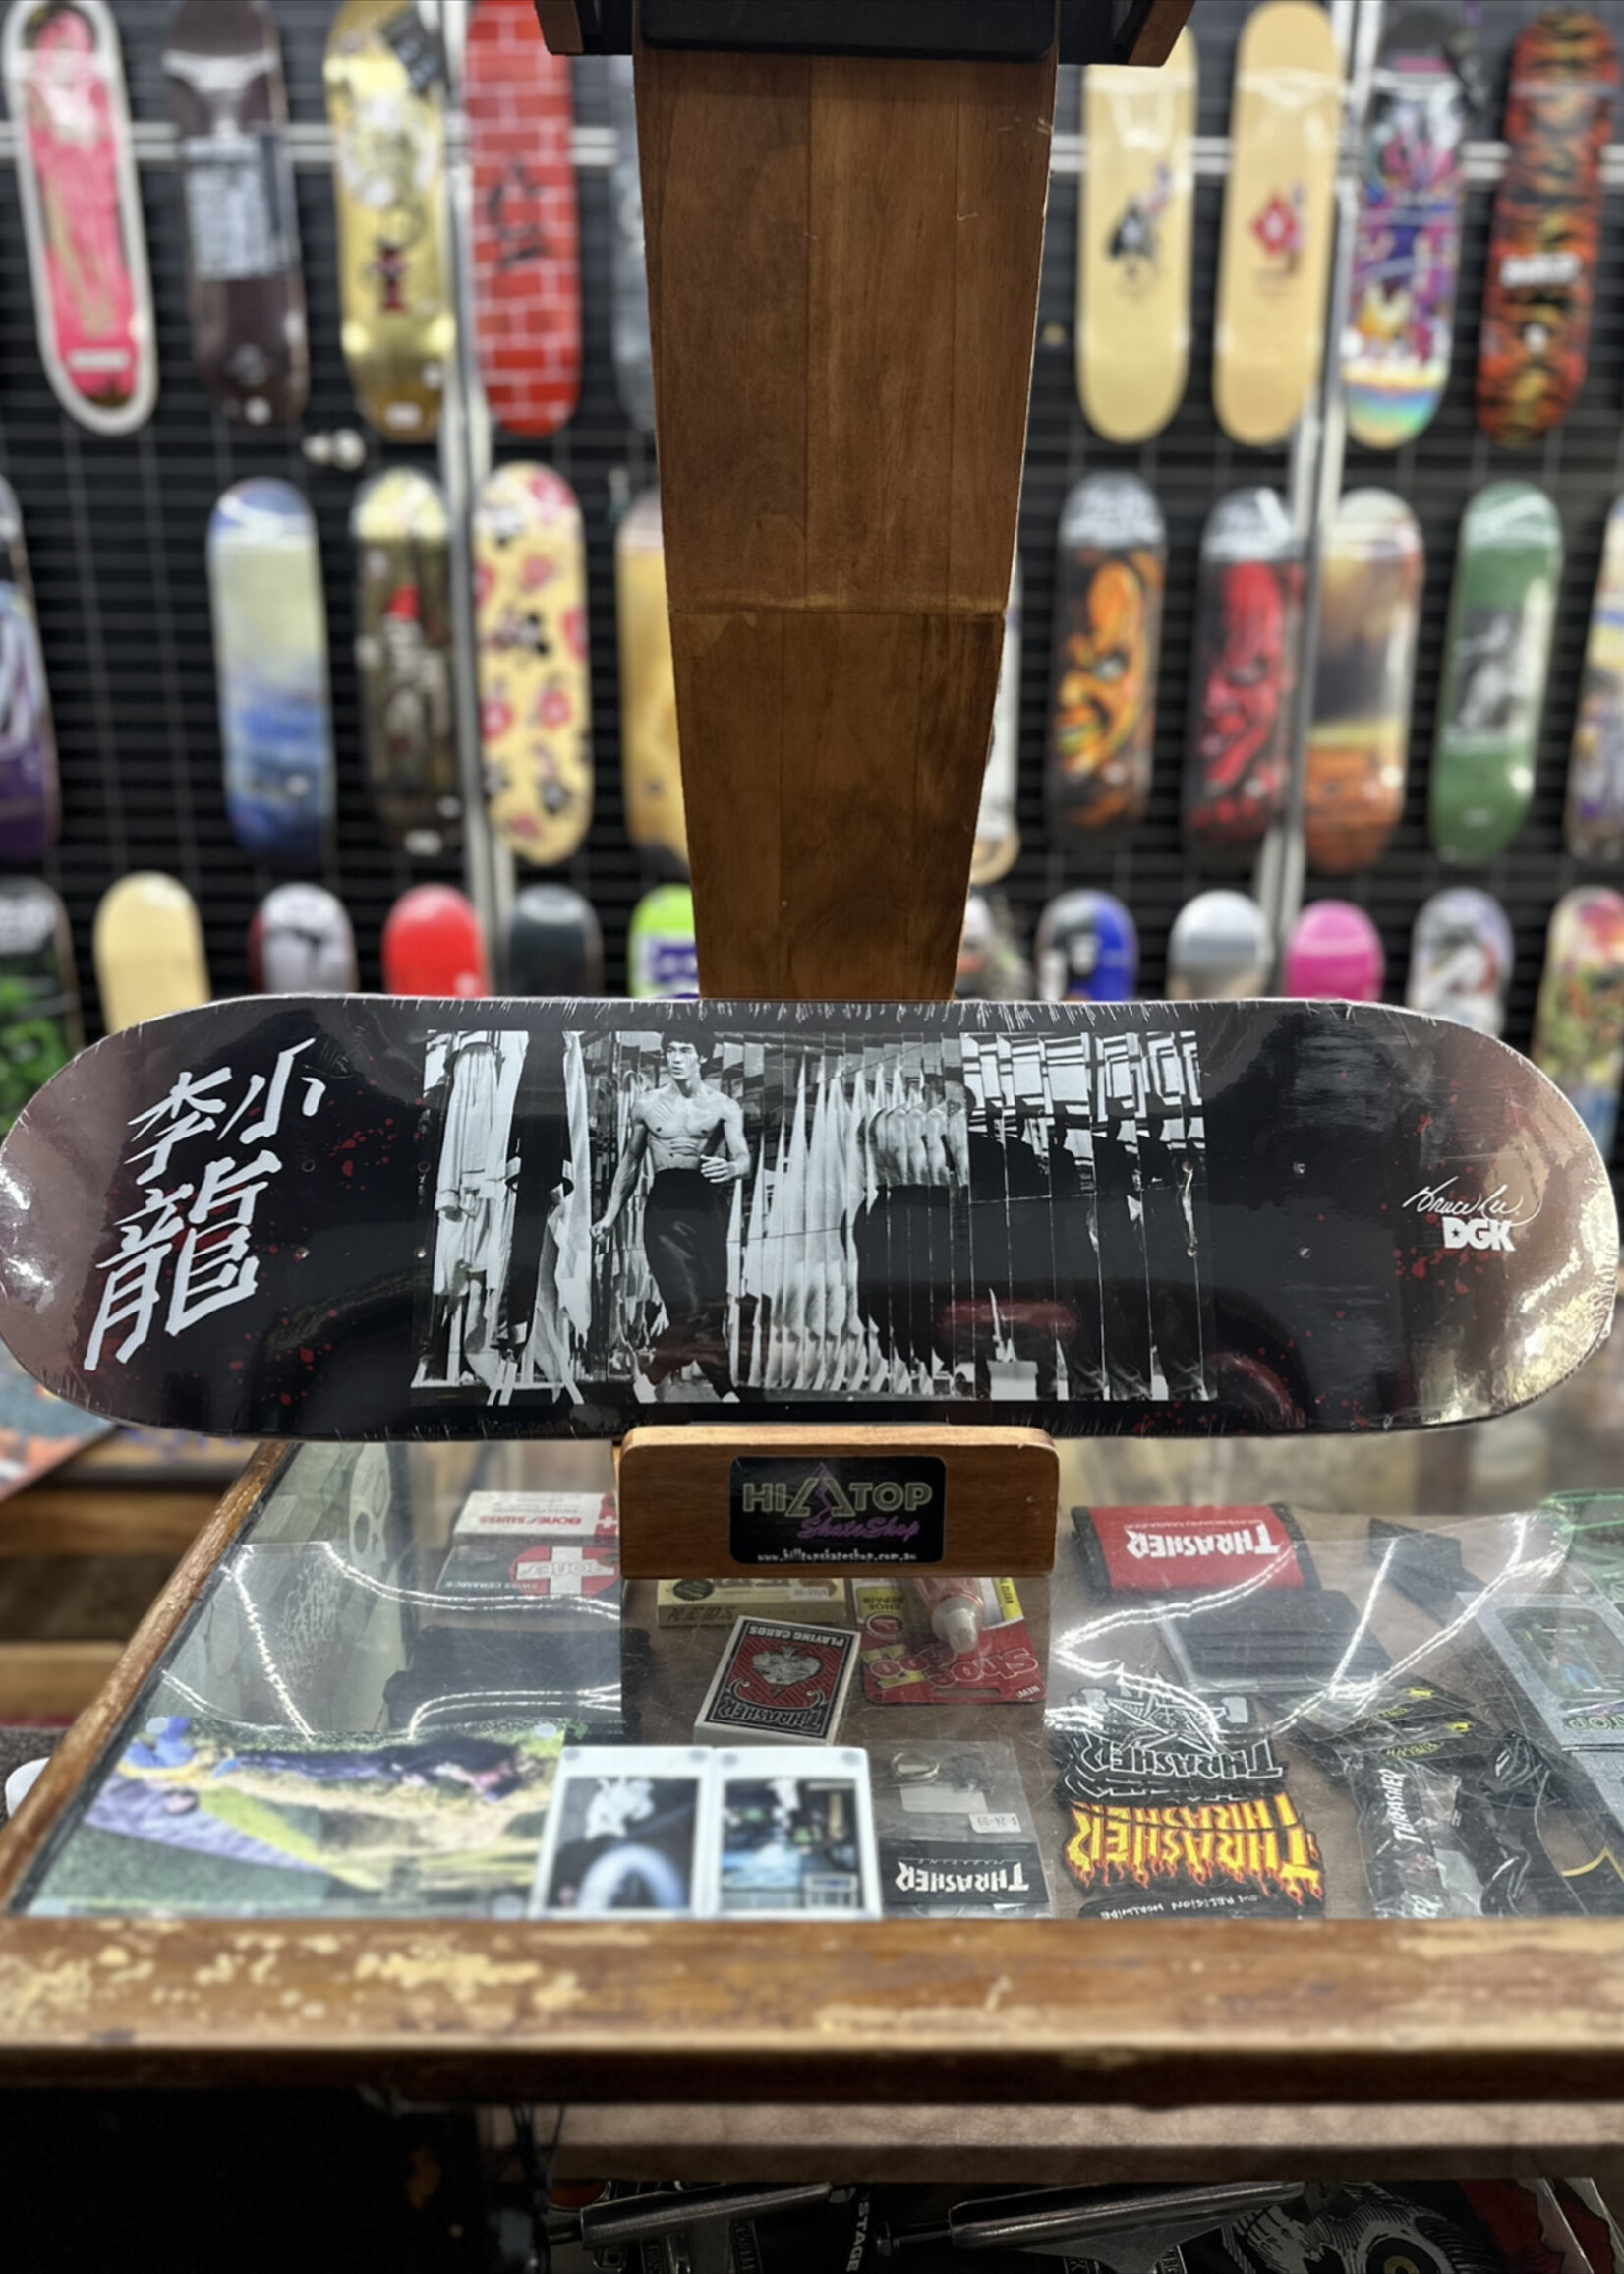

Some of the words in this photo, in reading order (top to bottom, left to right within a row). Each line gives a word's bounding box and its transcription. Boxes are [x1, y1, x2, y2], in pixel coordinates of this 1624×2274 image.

[1441, 1216, 1516, 1252] DGK
[1124, 1522, 1280, 1560] THRASHER
[748, 1625, 791, 1640] CARDS
[792, 1630, 845, 1648] PLAYING
[717, 1695, 823, 1732] THRASHER
[1080, 1729, 1284, 1780] THRASHER
[1378, 1767, 1425, 1845] THRASHER
[1067, 1806, 1321, 1901] THRASHER
[895, 1860, 1030, 1893] THRASHER
